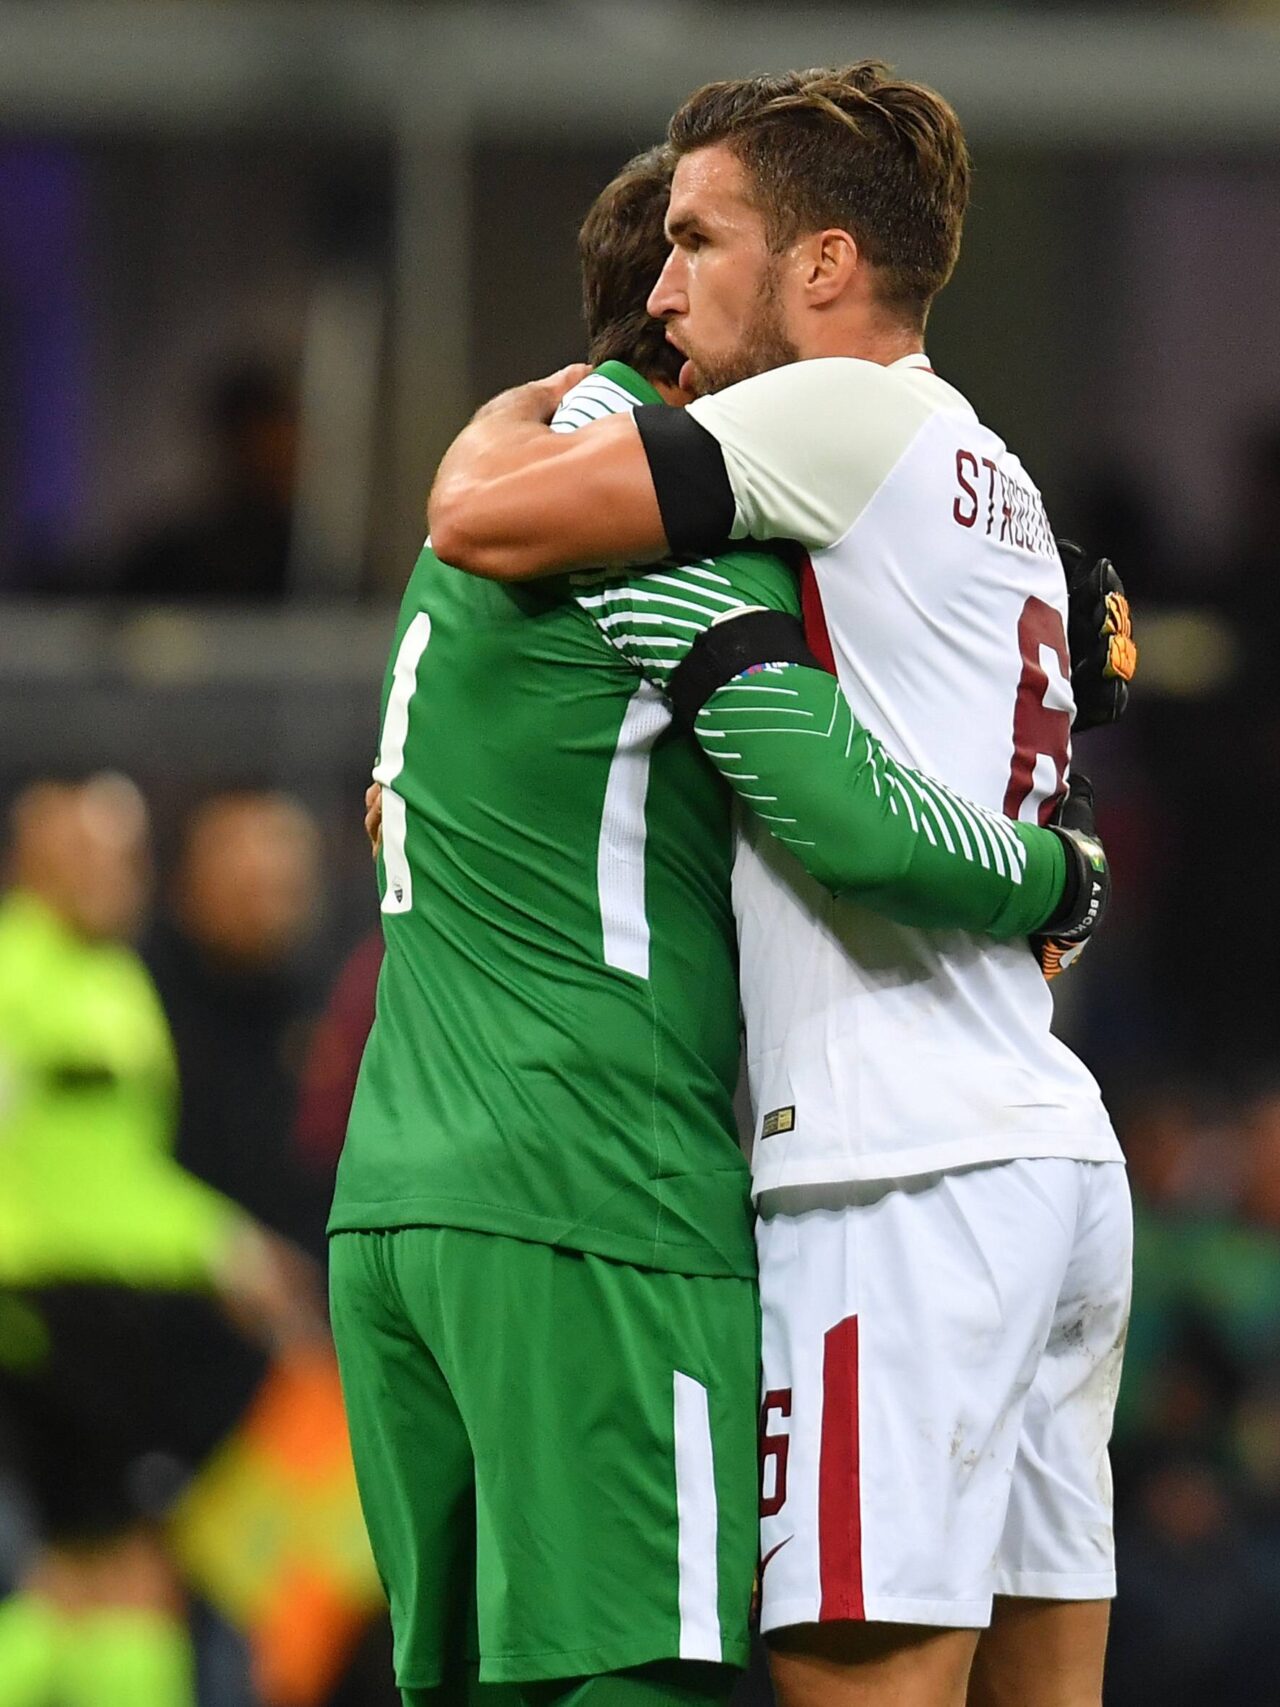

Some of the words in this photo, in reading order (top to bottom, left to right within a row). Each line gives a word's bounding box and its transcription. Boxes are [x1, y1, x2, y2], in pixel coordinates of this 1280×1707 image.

[371, 611, 432, 914] 1
[1003, 595, 1070, 827] 6
[1091, 881, 1102, 897] A.
[759, 1387, 792, 1519] 6
